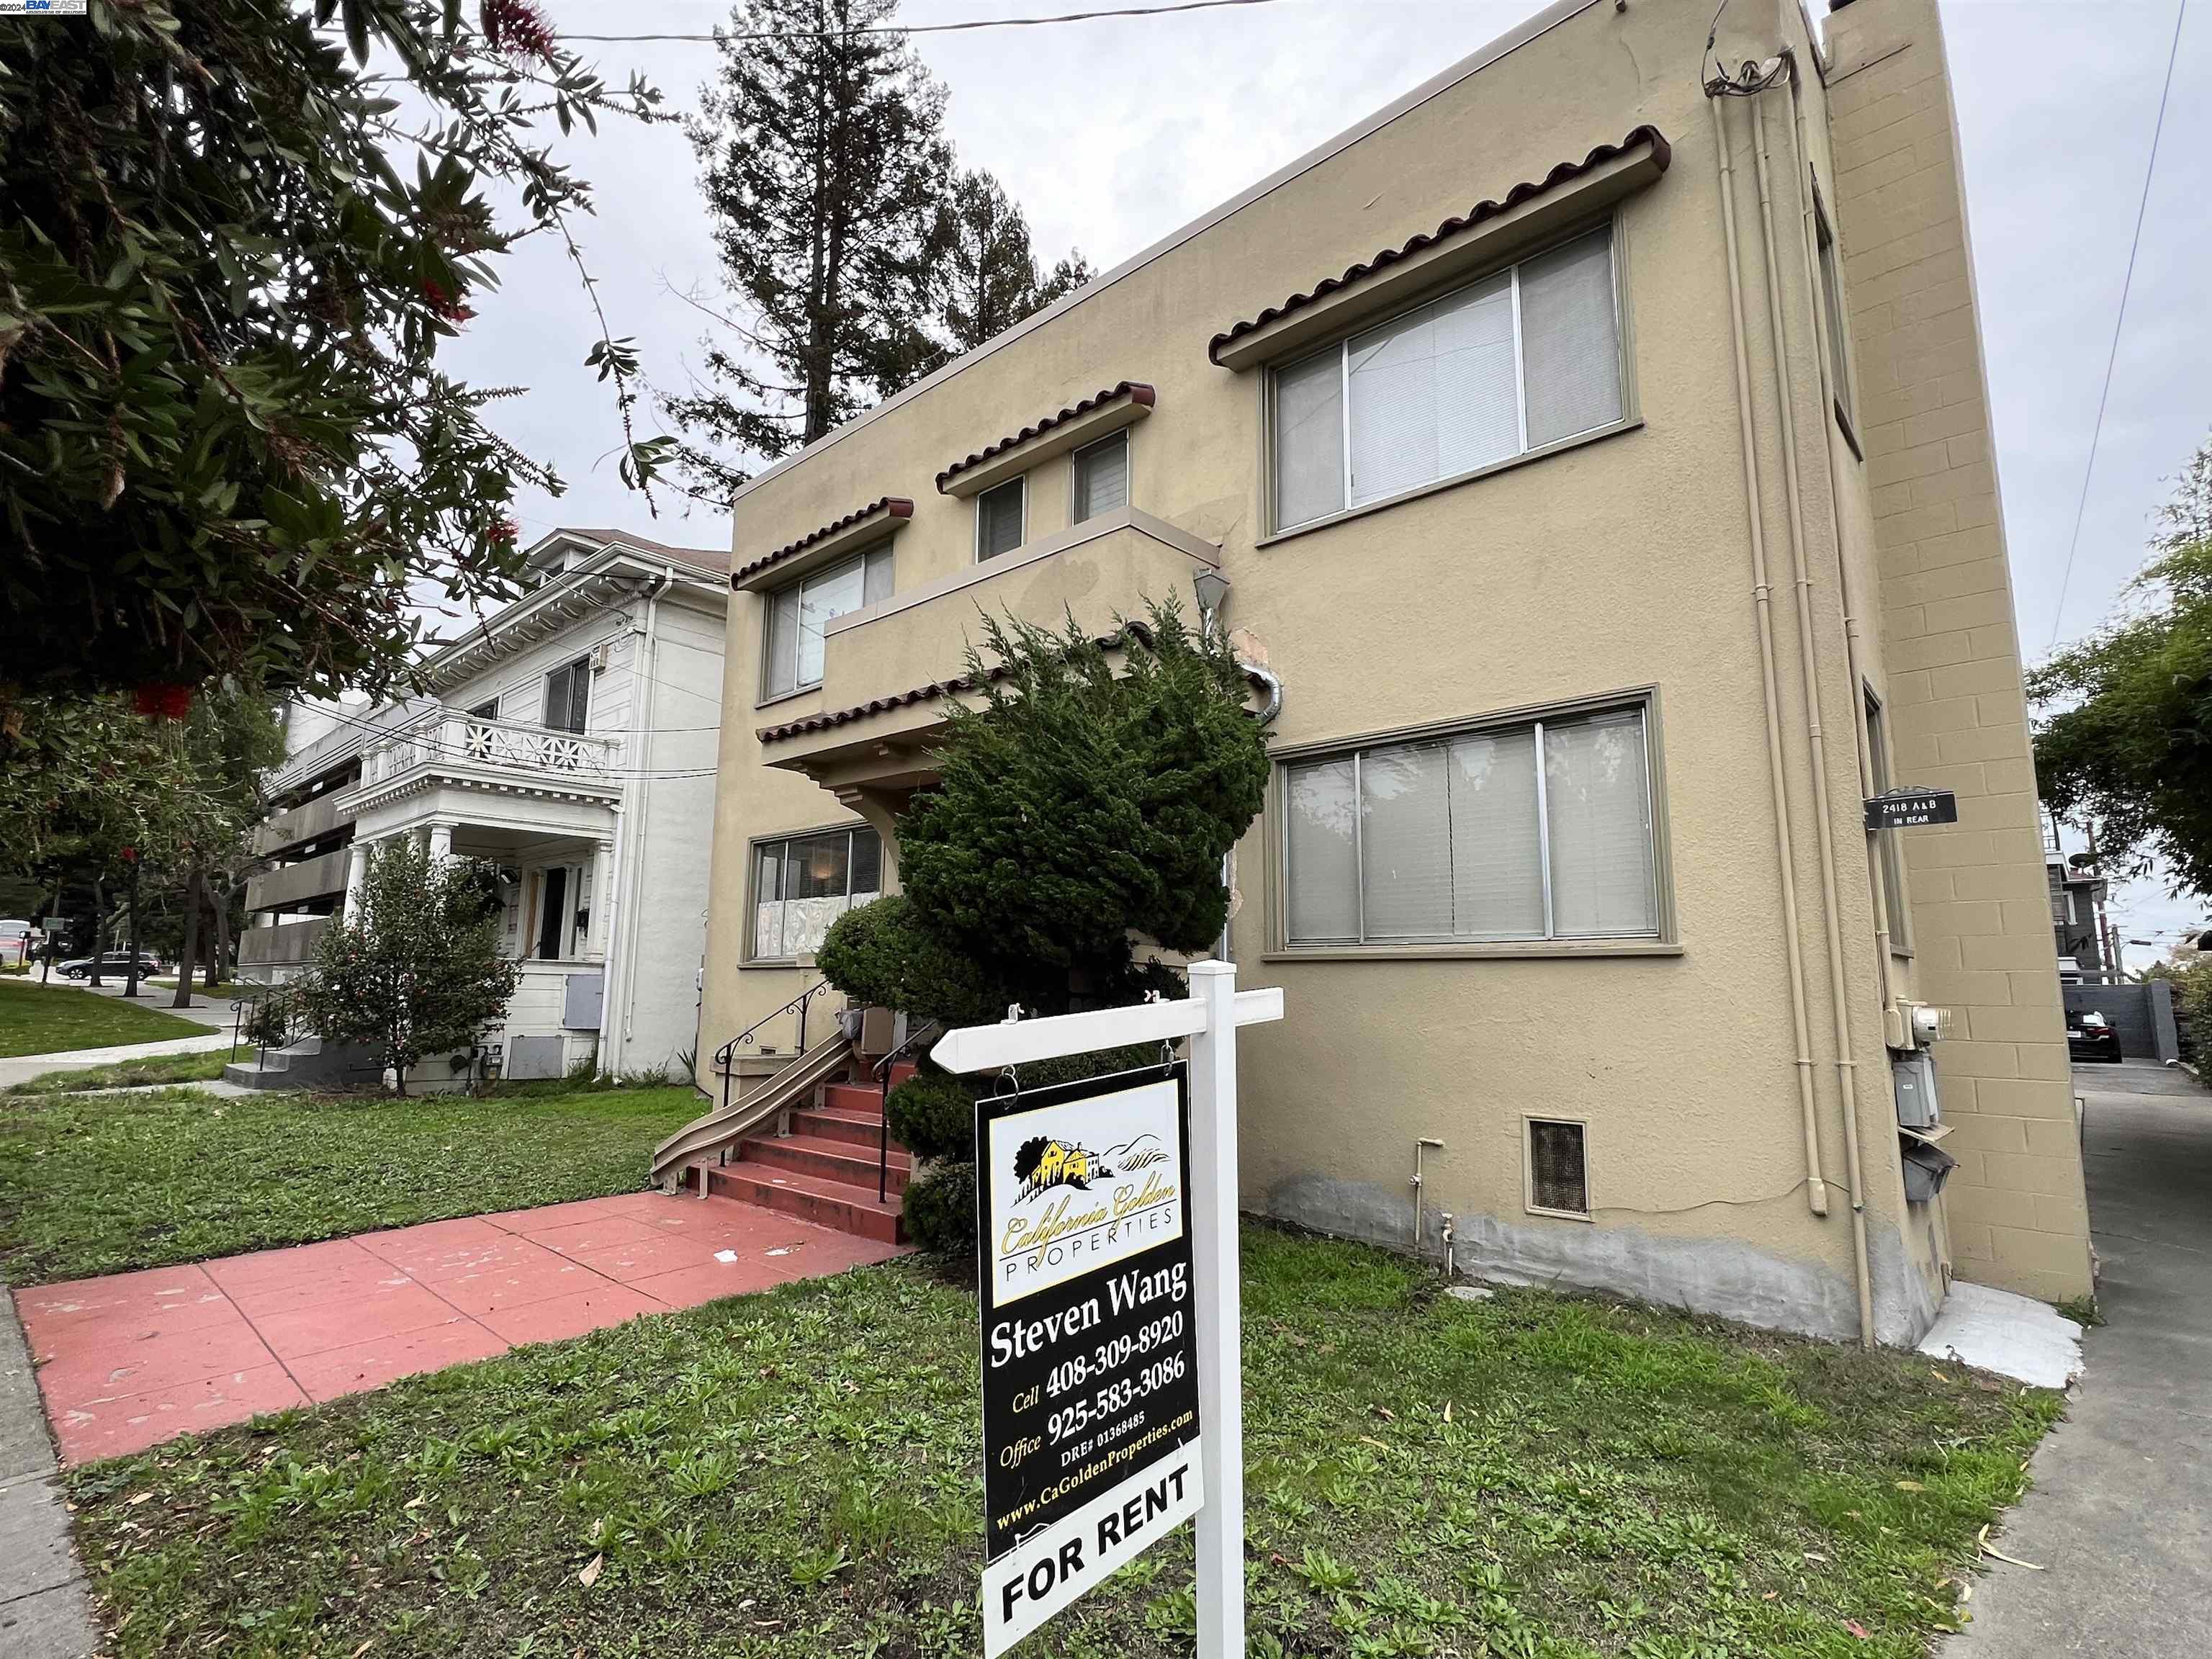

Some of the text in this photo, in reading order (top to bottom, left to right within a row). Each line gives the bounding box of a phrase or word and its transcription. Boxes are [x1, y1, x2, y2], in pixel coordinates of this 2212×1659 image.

[1882, 803, 1907, 813] 2418
[1929, 800, 1936, 809] B
[1906, 815, 1930, 824] REAR
[1002, 1171, 1175, 1267] California Golden
[1006, 1208, 1172, 1282] PROPERTIES
[991, 1262, 1187, 1368] Steven Wang
[1012, 1310, 1184, 1413] Cell 408-309-8920
[1000, 1350, 1185, 1470] Office 925-583-3086
[1061, 1410, 1145, 1467] DRE# 01368485
[997, 1408, 1193, 1531] www.CaGoldenProperties.com
[1002, 1462, 1189, 1624] FOR RENT
